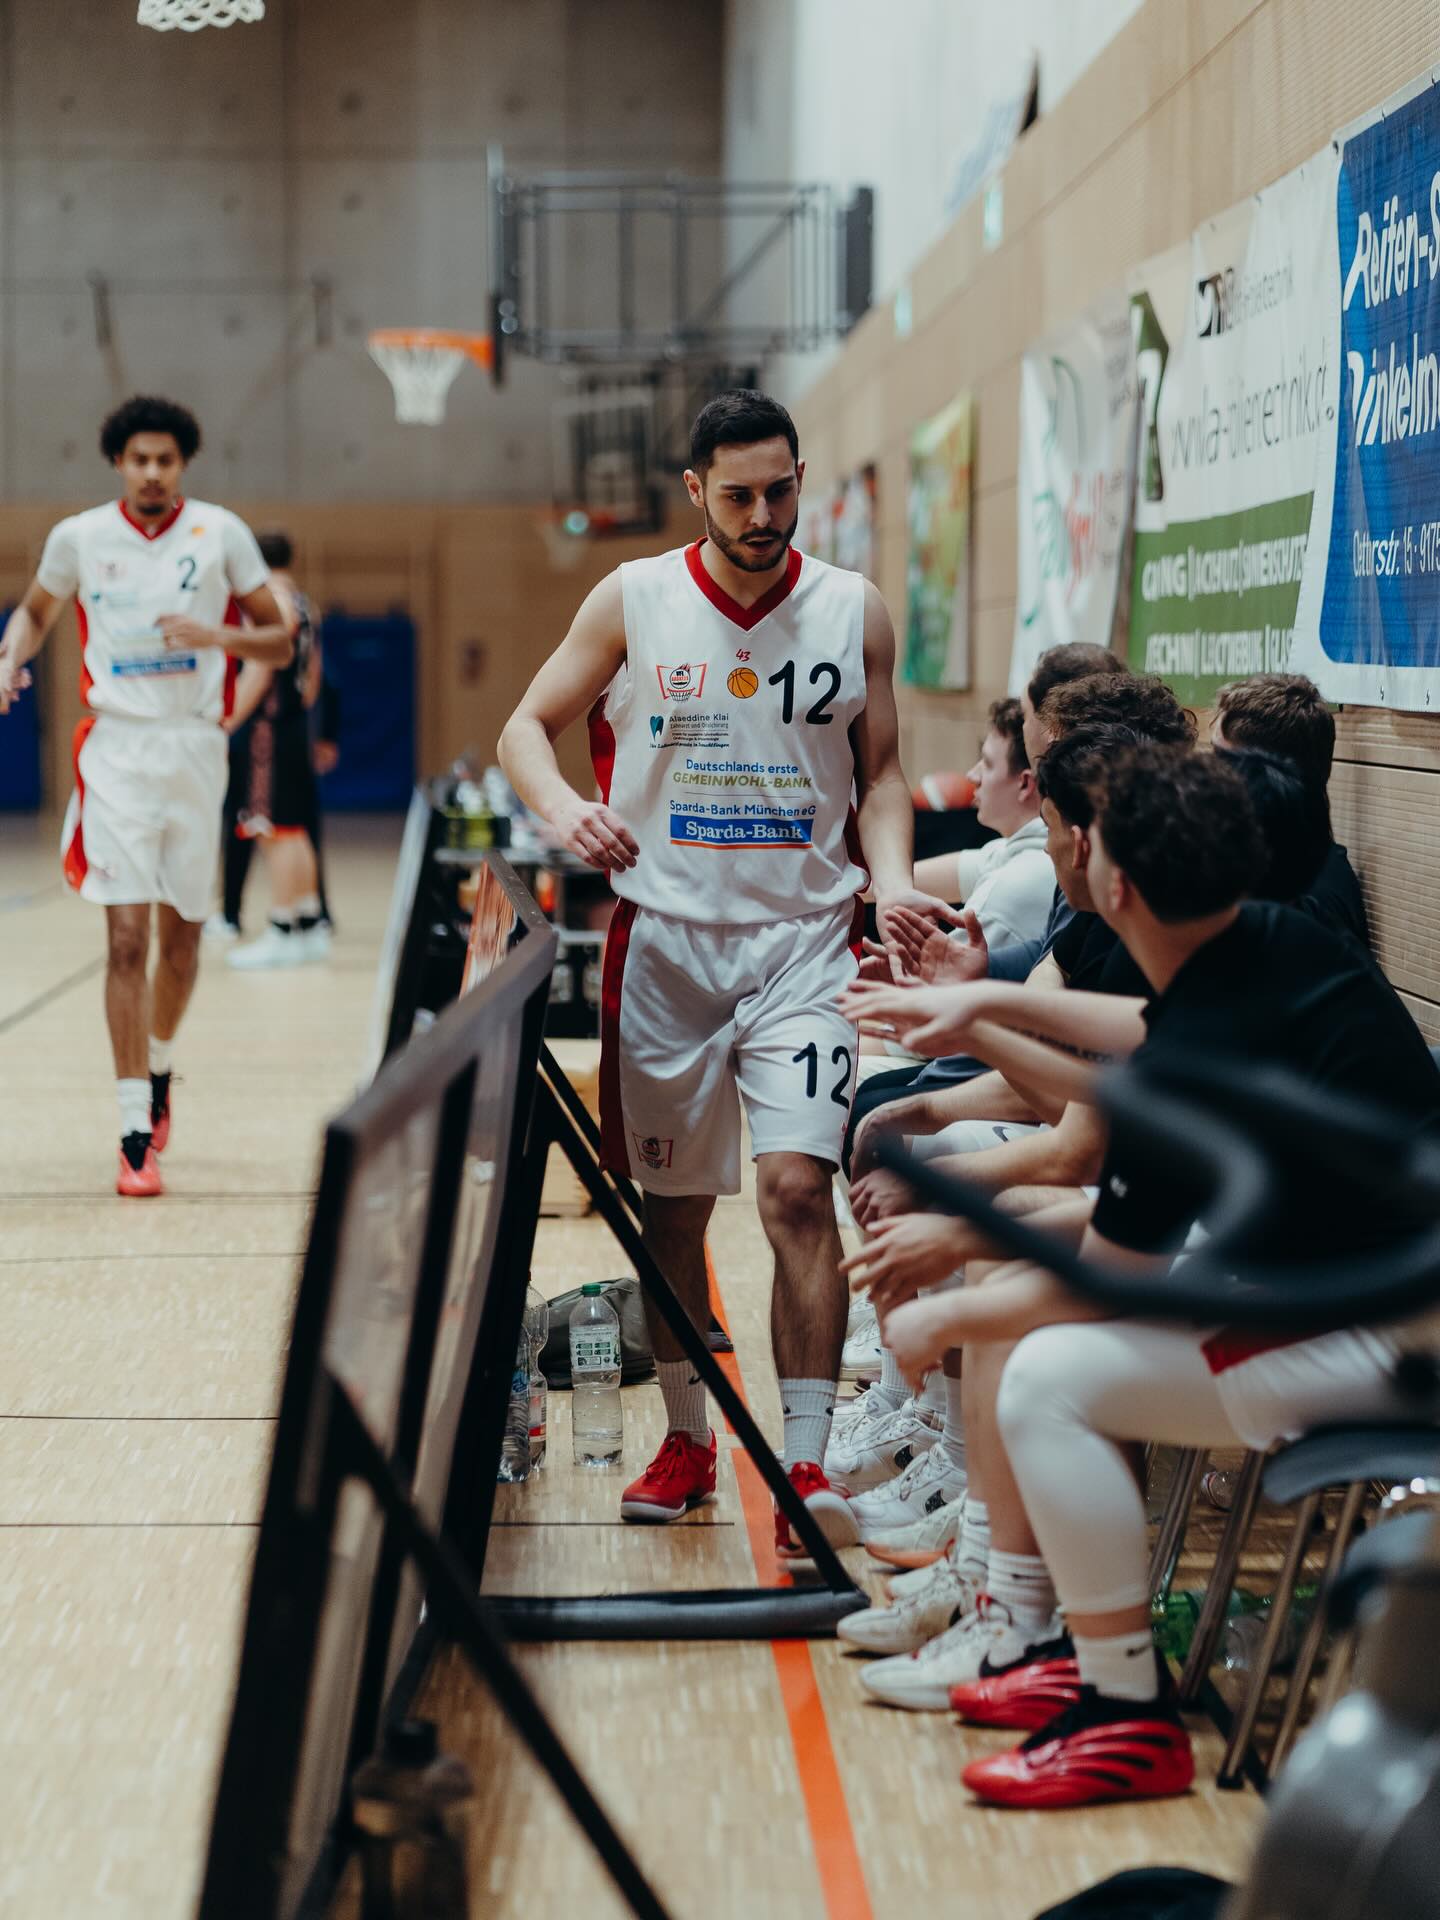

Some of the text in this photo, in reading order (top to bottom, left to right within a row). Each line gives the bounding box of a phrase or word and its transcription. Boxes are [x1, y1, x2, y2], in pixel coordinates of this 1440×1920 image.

[177, 556, 199, 592] 2
[768, 659, 841, 725] 12
[686, 759, 799, 774] Deutschlands erste
[673, 772, 812, 788] GEMEINWOHL-BANK
[670, 800, 740, 815] Sparda-Bank
[744, 803, 800, 816] München
[686, 820, 803, 840] Sparda-Bank
[792, 1041, 851, 1109] 12
